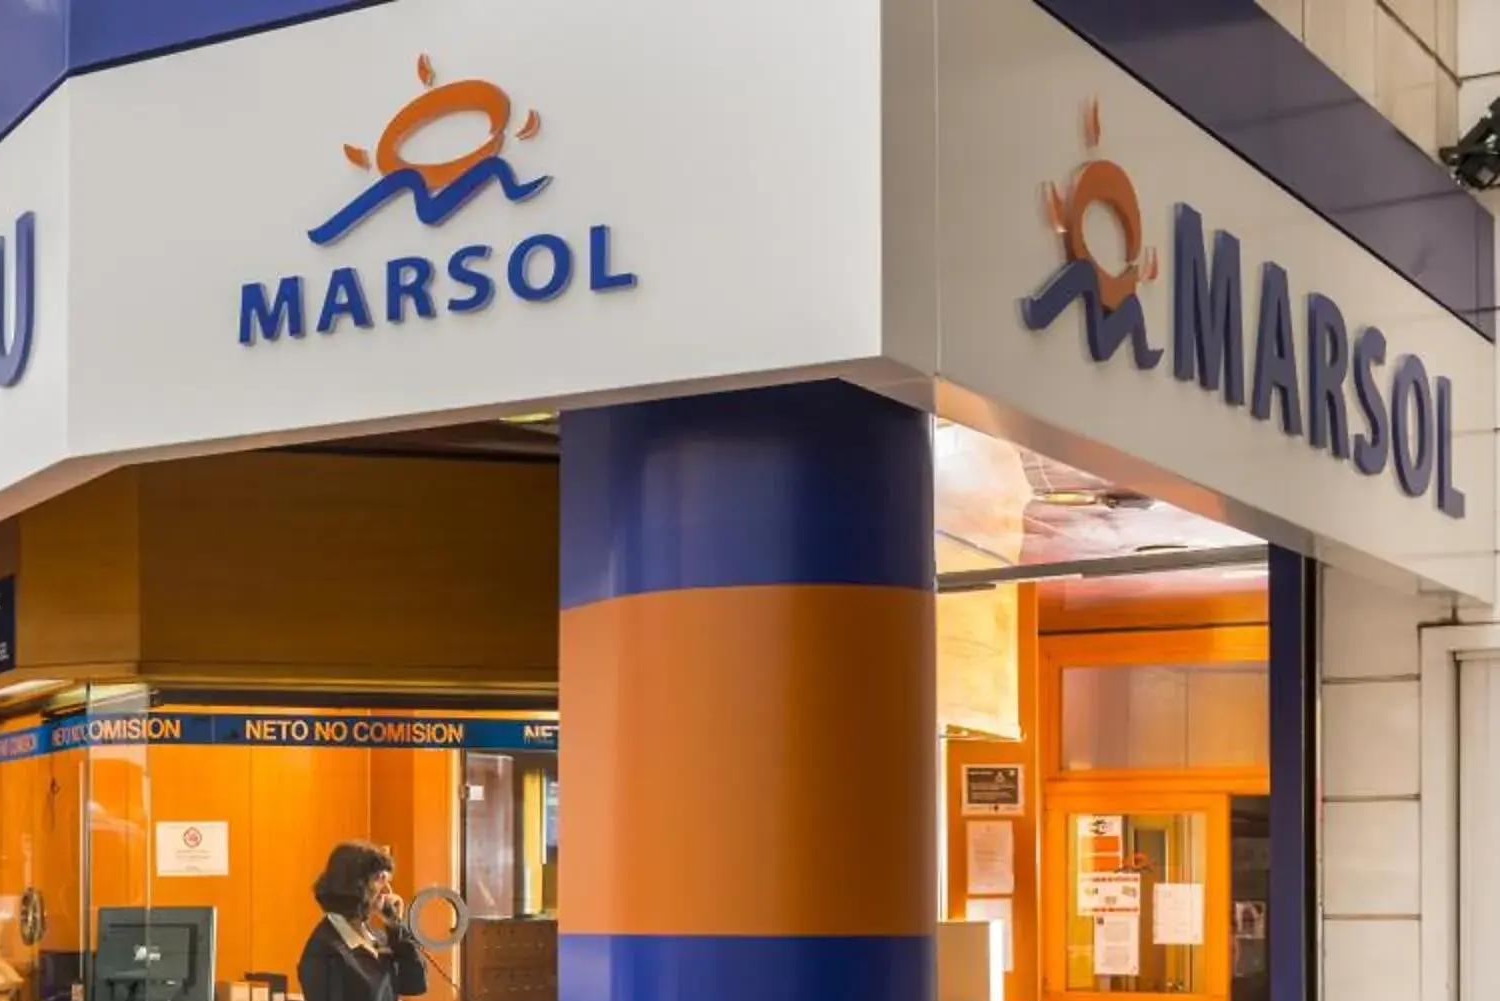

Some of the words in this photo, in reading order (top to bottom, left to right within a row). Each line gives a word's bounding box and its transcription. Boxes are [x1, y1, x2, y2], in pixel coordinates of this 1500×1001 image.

[238, 223, 637, 347] MARSOL
[1173, 201, 1466, 520] MARSOL
[246, 719, 308, 741] NETO
[314, 720, 348, 742] NO
[353, 721, 464, 744] COMISION
